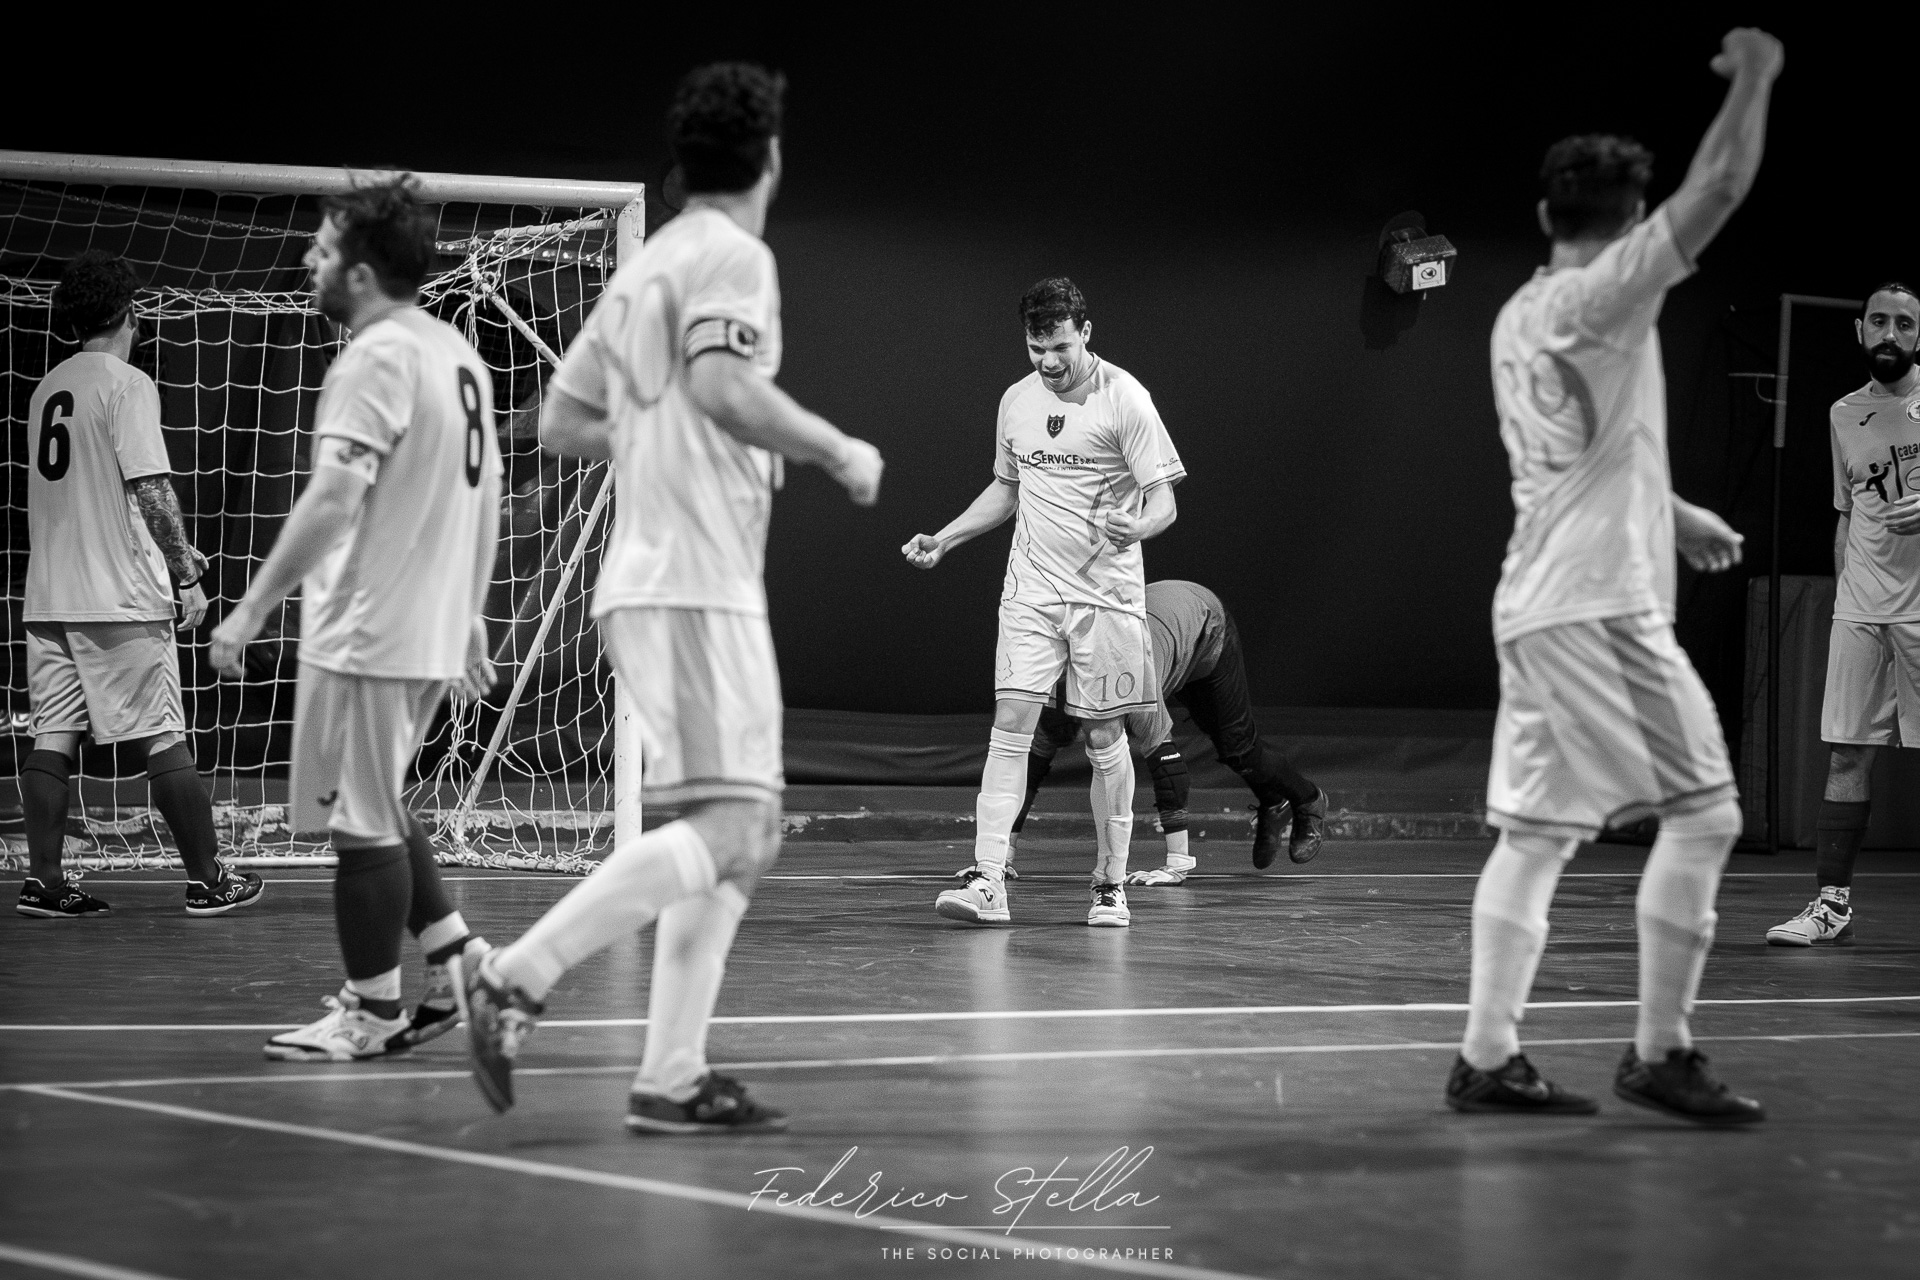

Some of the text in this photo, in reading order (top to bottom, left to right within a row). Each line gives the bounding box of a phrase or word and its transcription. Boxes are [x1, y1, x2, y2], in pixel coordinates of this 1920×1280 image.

[37, 390, 74, 481] 6
[457, 364, 484, 488] 8
[1097, 671, 1136, 702] 10
